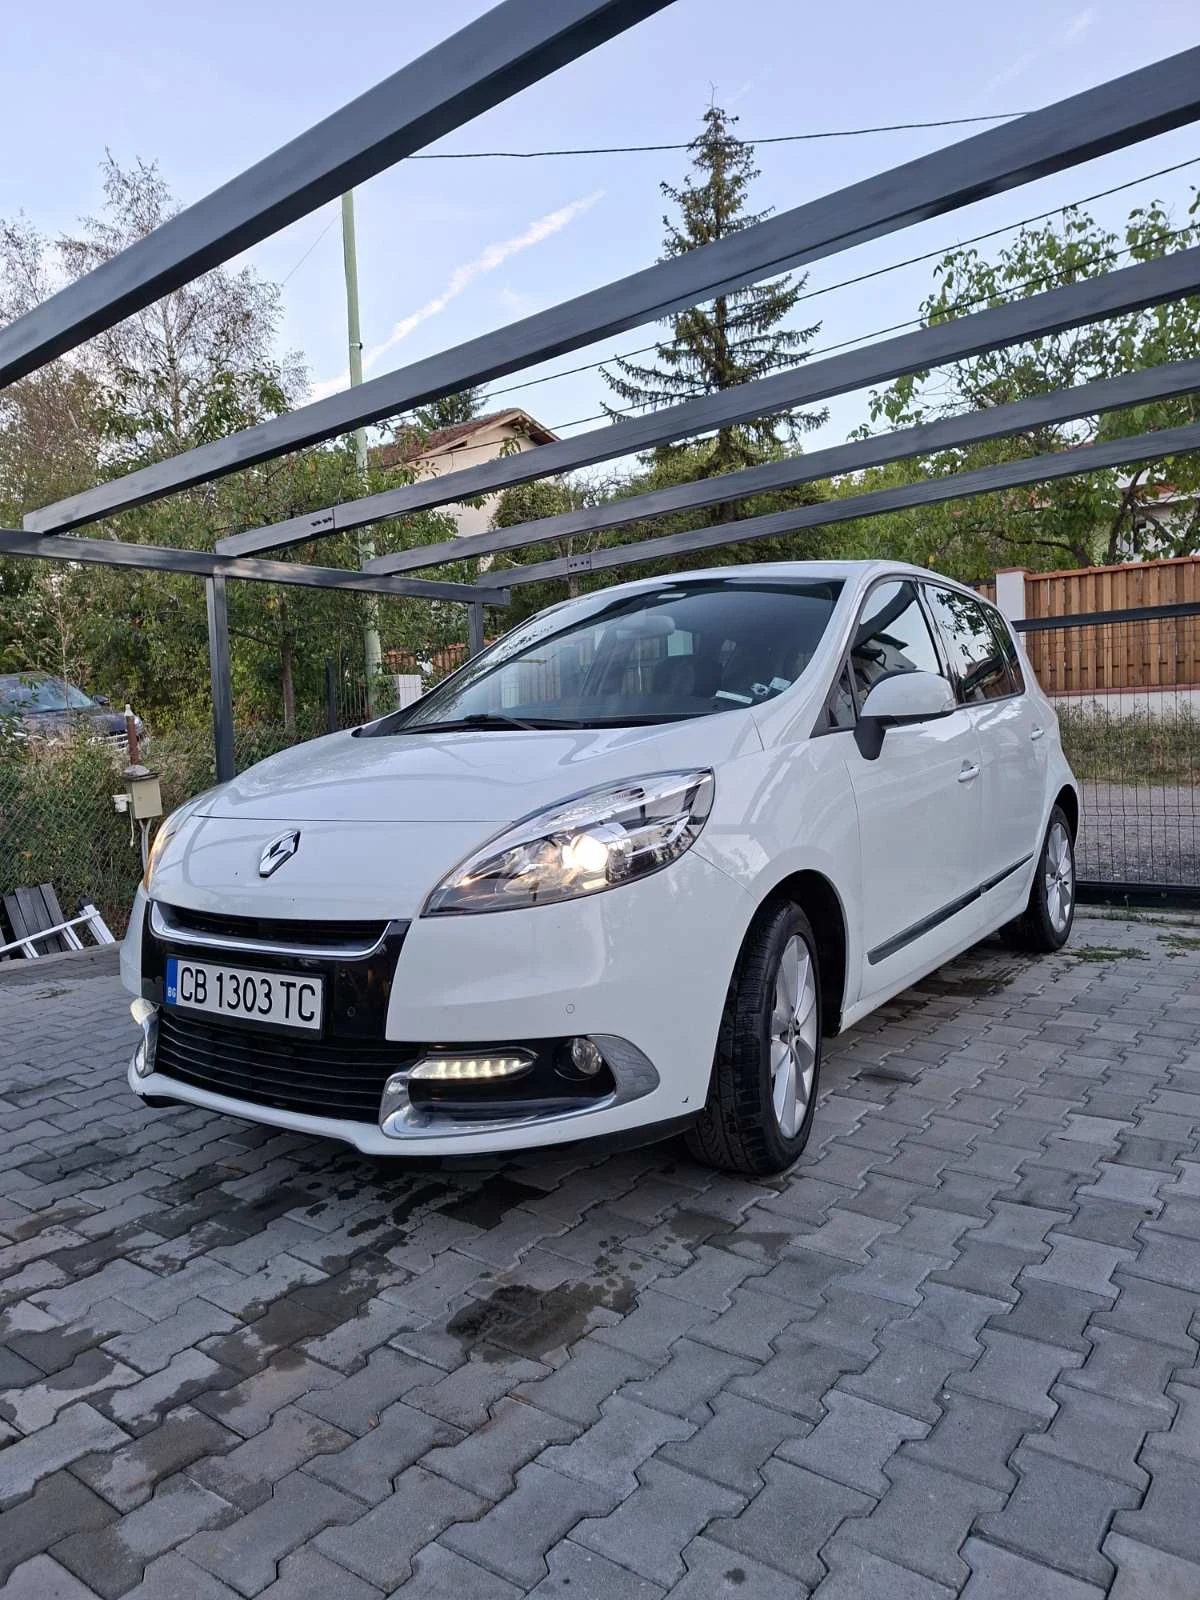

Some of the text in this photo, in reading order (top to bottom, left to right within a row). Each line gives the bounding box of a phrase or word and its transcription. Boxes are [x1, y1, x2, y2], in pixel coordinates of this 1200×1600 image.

[181, 967, 316, 1022] CB 1303 TC
